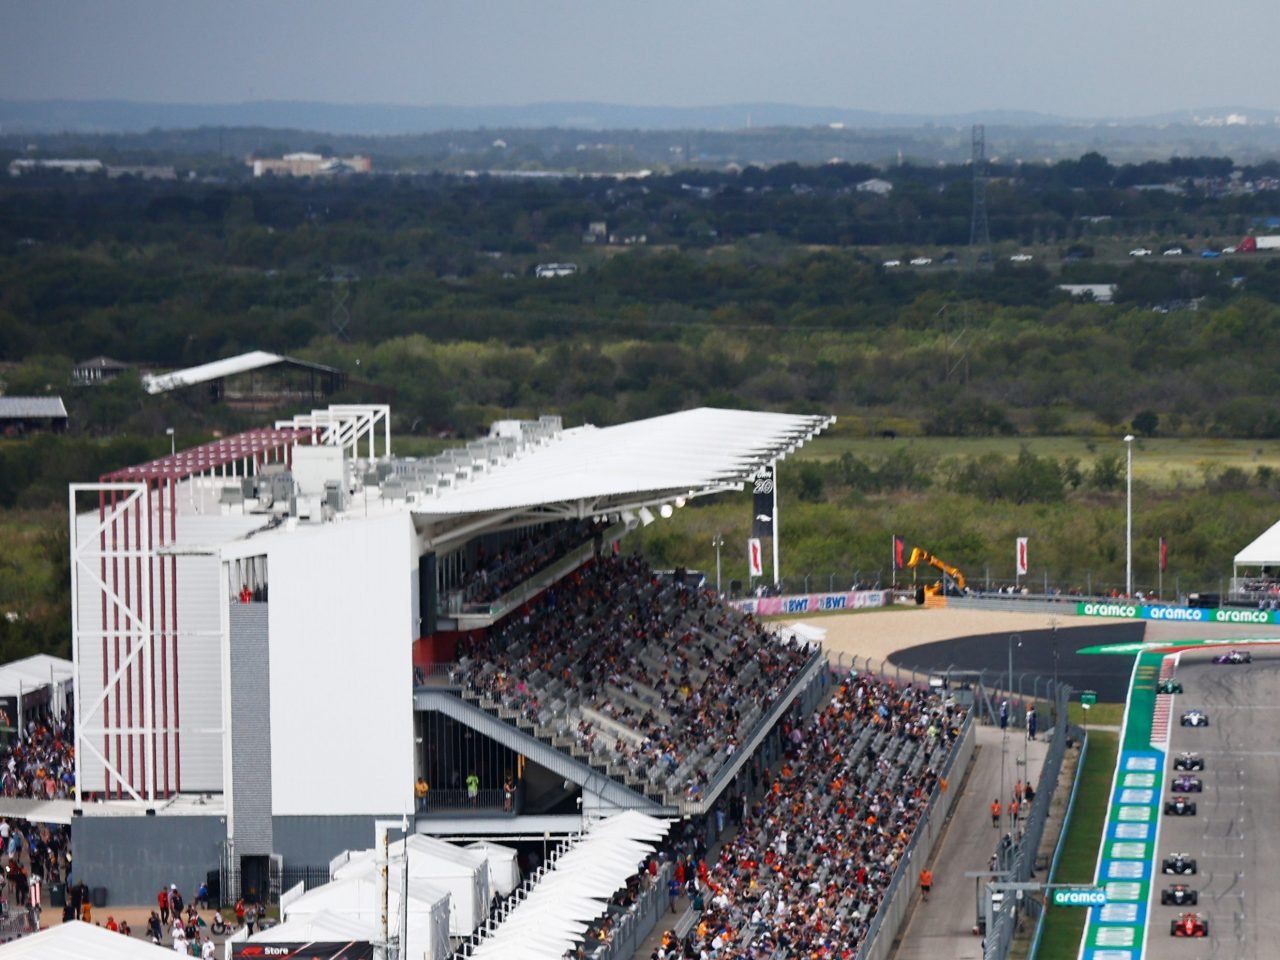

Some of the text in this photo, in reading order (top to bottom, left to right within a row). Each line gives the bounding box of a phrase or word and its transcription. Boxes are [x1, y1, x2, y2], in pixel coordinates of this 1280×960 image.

[1084, 604, 1136, 617] aramco
[1150, 606, 1202, 620] aramco
[1216, 609, 1268, 622] aramco
[1055, 892, 1106, 903] aramco
[264, 946, 289, 955] Store
